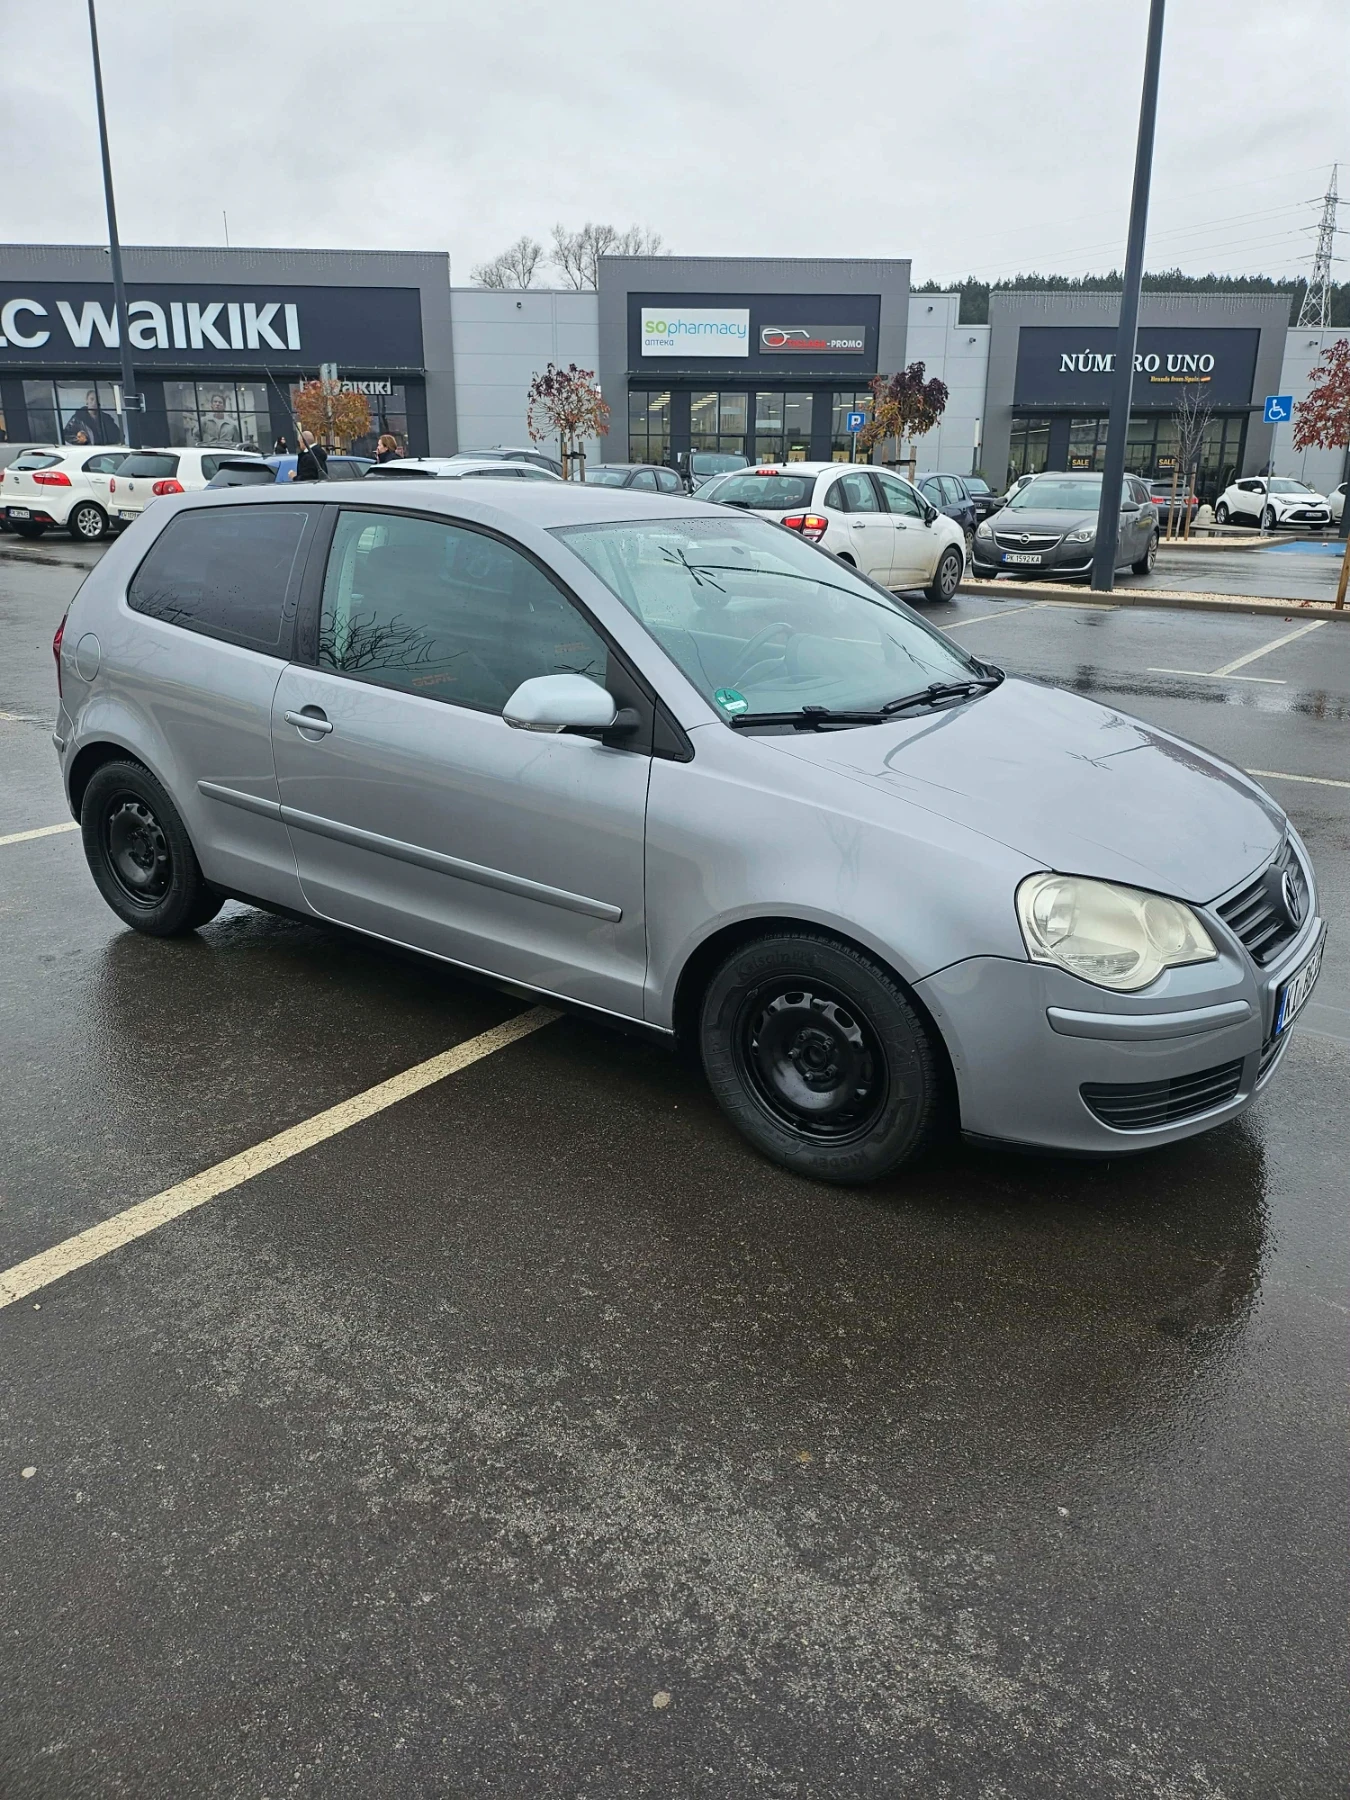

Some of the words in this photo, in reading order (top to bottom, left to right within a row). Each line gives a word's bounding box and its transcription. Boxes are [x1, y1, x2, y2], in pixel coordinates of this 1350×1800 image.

[0, 299, 51, 348] C
[1059, 348, 1160, 372] NÚMRO
[1167, 354, 1215, 372] UNO
[1158, 458, 1176, 466] SALE
[1016, 555, 1031, 563] 1592
